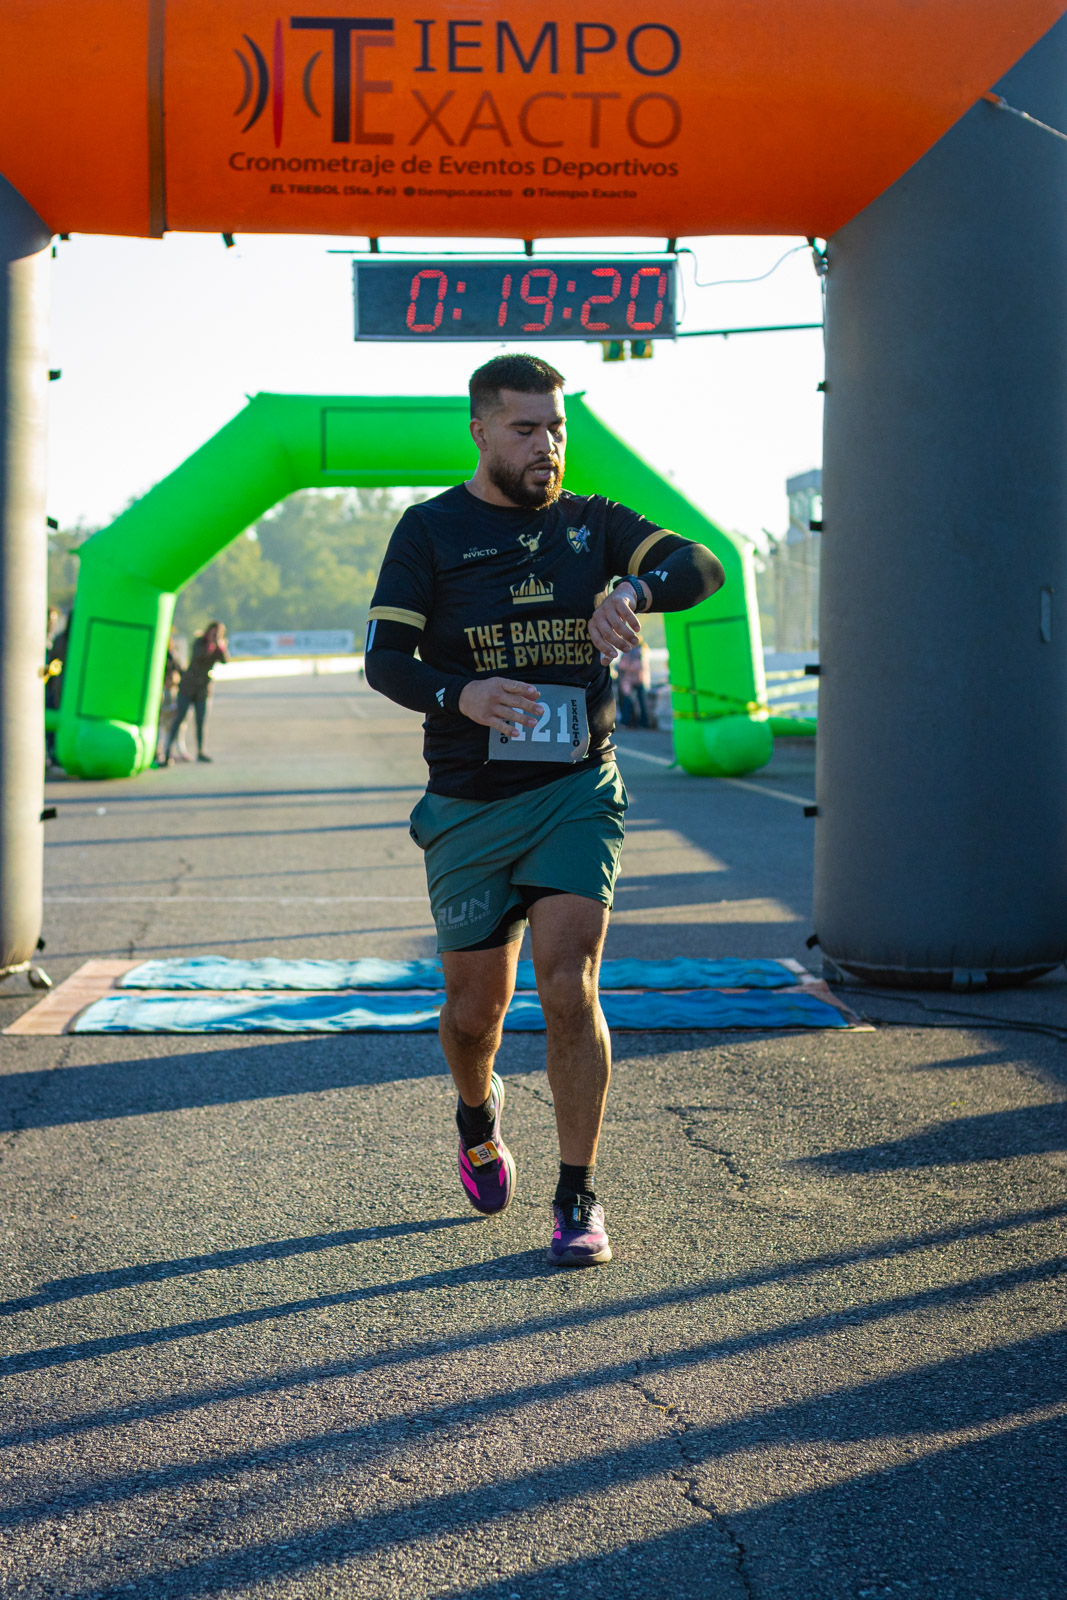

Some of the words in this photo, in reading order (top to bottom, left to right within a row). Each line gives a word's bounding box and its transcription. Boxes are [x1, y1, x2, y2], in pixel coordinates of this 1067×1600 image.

[229, 151, 394, 178] Cronometraje
[401, 155, 432, 175] de
[439, 156, 535, 175] Eventos
[543, 157, 678, 180] Deportivos
[270, 184, 285, 194] EL
[288, 184, 339, 195] TREBOL
[537, 187, 589, 199] Tiempo
[592, 188, 637, 199] Exacto
[463, 548, 498, 559] INVICTO
[463, 624, 505, 649] THE
[510, 618, 592, 644] BARBER
[571, 699, 580, 747] EXACTO
[437, 890, 491, 926] RUN
